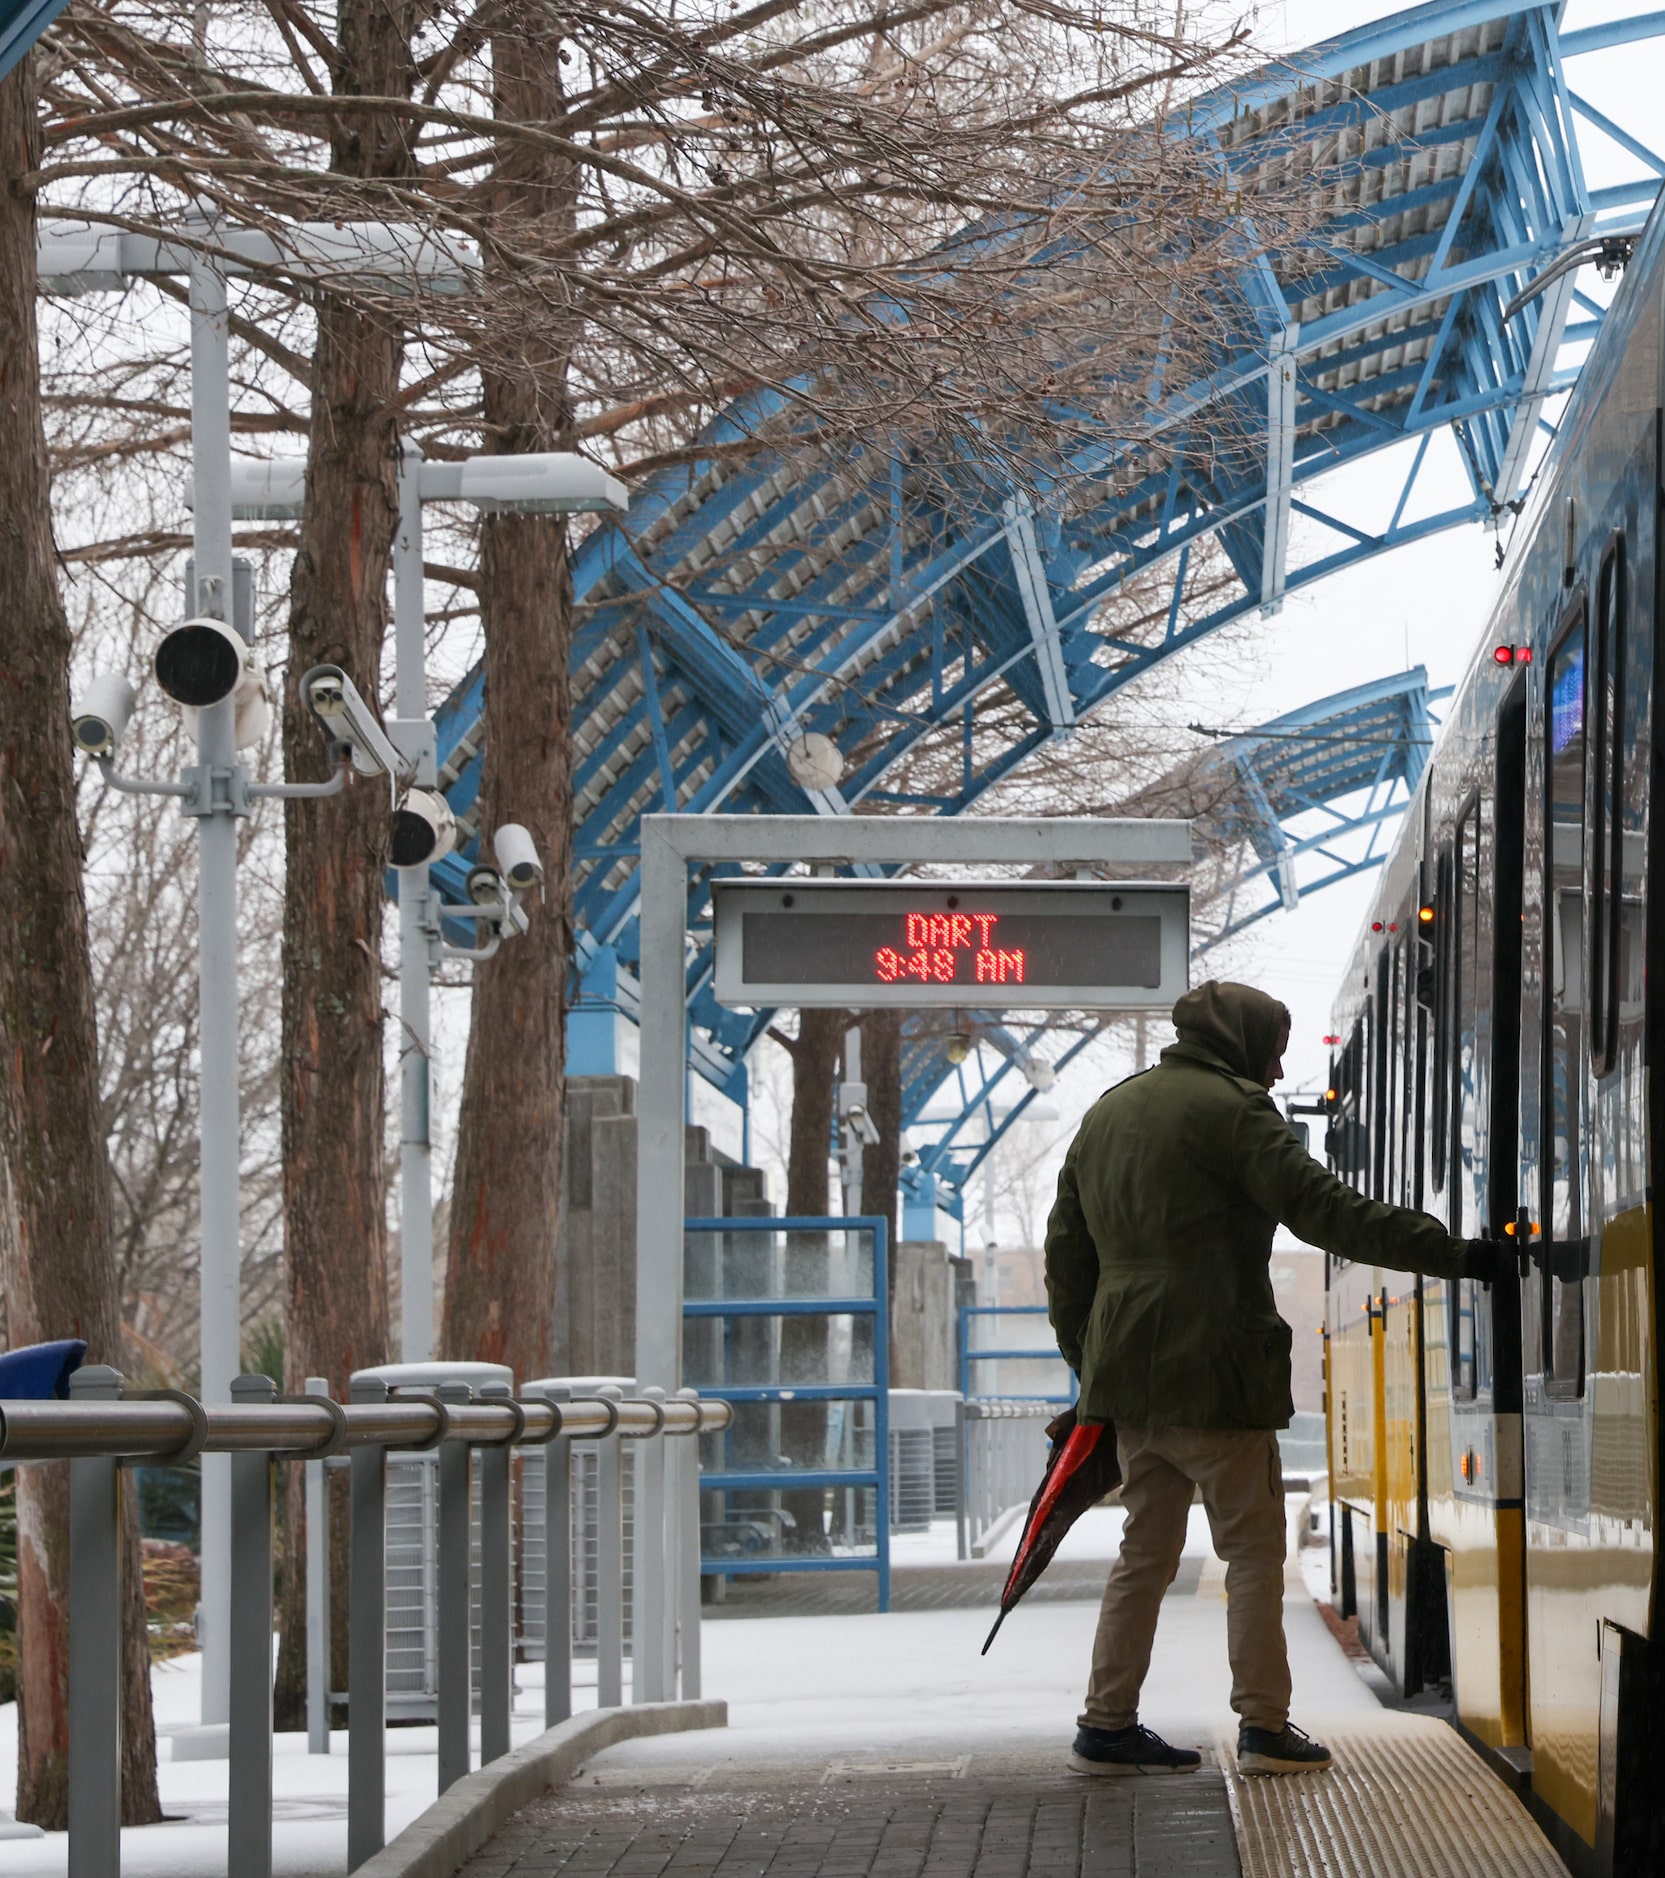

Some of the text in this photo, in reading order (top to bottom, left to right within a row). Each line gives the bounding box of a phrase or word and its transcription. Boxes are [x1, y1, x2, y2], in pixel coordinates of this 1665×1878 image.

[906, 912, 999, 948] DART
[875, 946, 1026, 983] 9:48 AM
